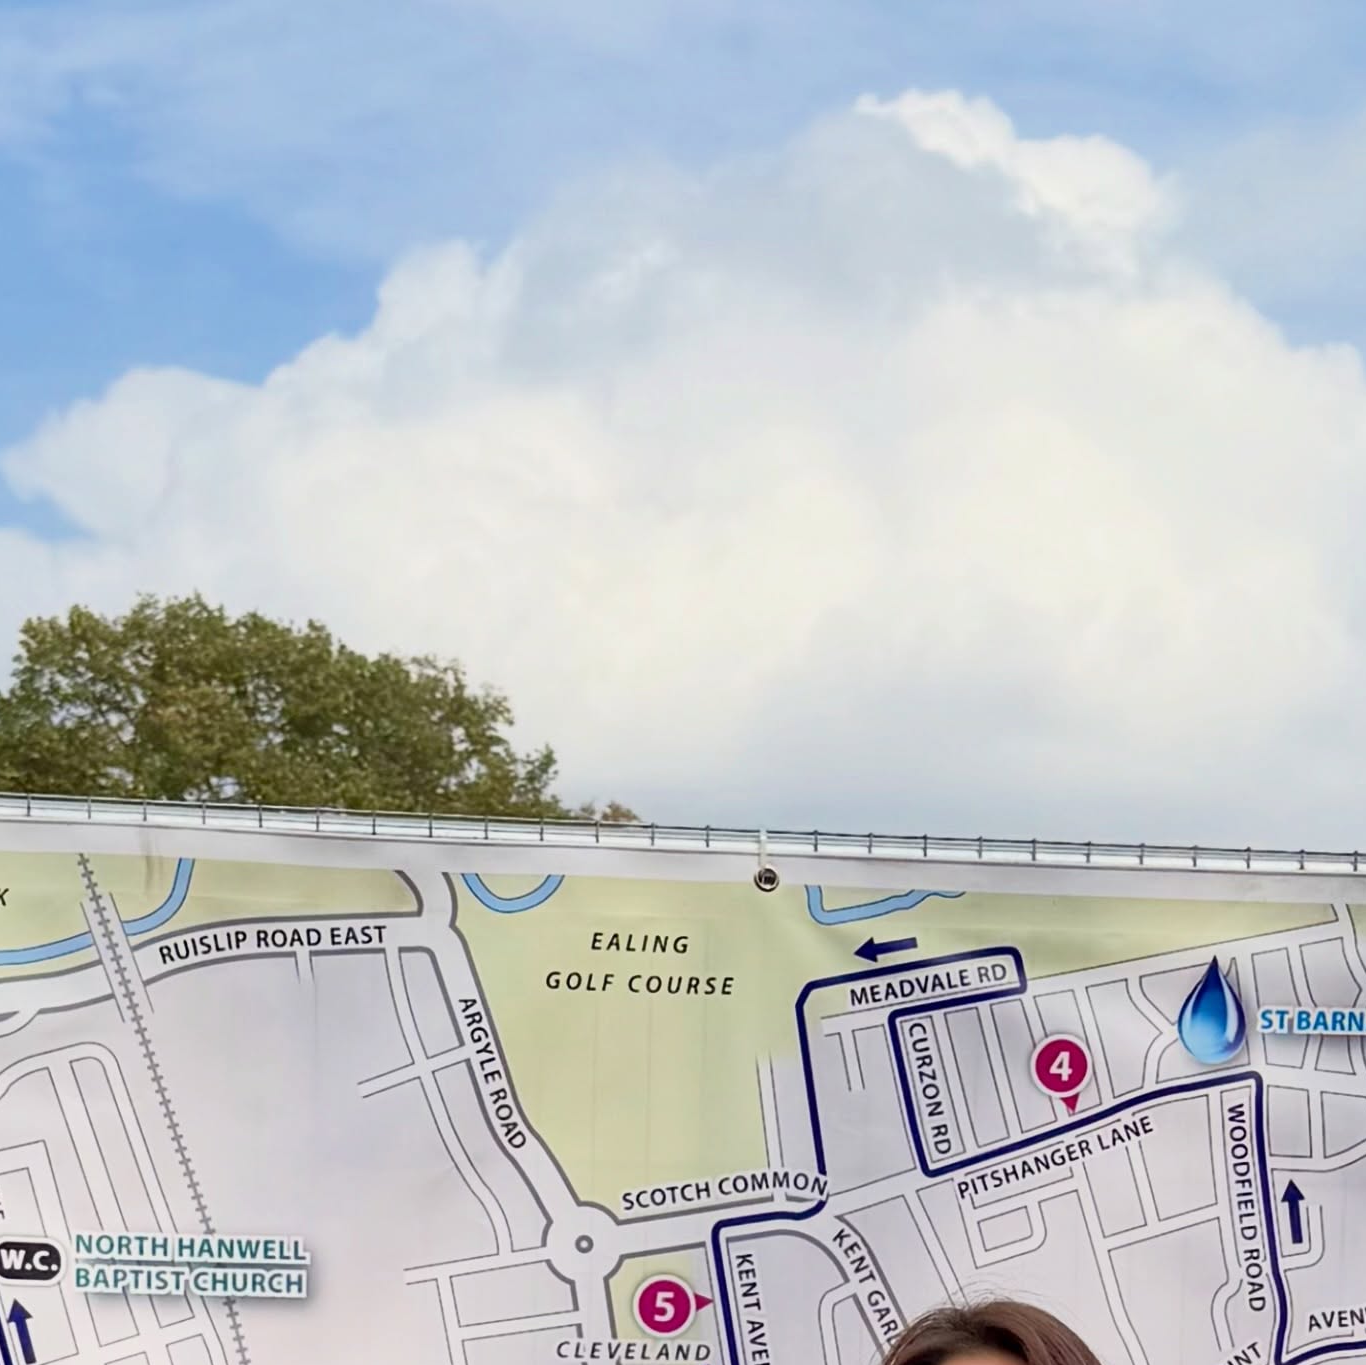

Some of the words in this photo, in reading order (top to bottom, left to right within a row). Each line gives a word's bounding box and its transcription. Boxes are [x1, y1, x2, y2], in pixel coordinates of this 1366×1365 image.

[159, 931, 247, 964] RUISLIP
[257, 928, 322, 948] ROAD
[331, 926, 386, 946] EAST
[591, 932, 689, 954] EALING
[546, 972, 614, 992] GOLF
[628, 975, 735, 995] COURSE
[850, 969, 971, 1005] MEADVALE
[977, 965, 1007, 983] RD
[1260, 1010, 1288, 1030] ST
[1050, 1052, 1073, 1081] 4
[958, 1139, 1092, 1199] PITSHANGER
[1098, 1115, 1153, 1152] LANE
[622, 1184, 711, 1210] SCOTCH
[718, 1173, 827, 1196] COMMON
[0, 1250, 59, 1271] W.C.
[76, 1234, 167, 1258] NORTH
[178, 1239, 306, 1261] HANWELL
[76, 1269, 184, 1290] BAPTIST
[193, 1272, 304, 1294] CHURCH
[654, 1293, 674, 1321] 5
[556, 1342, 711, 1361] CLEVELAND
